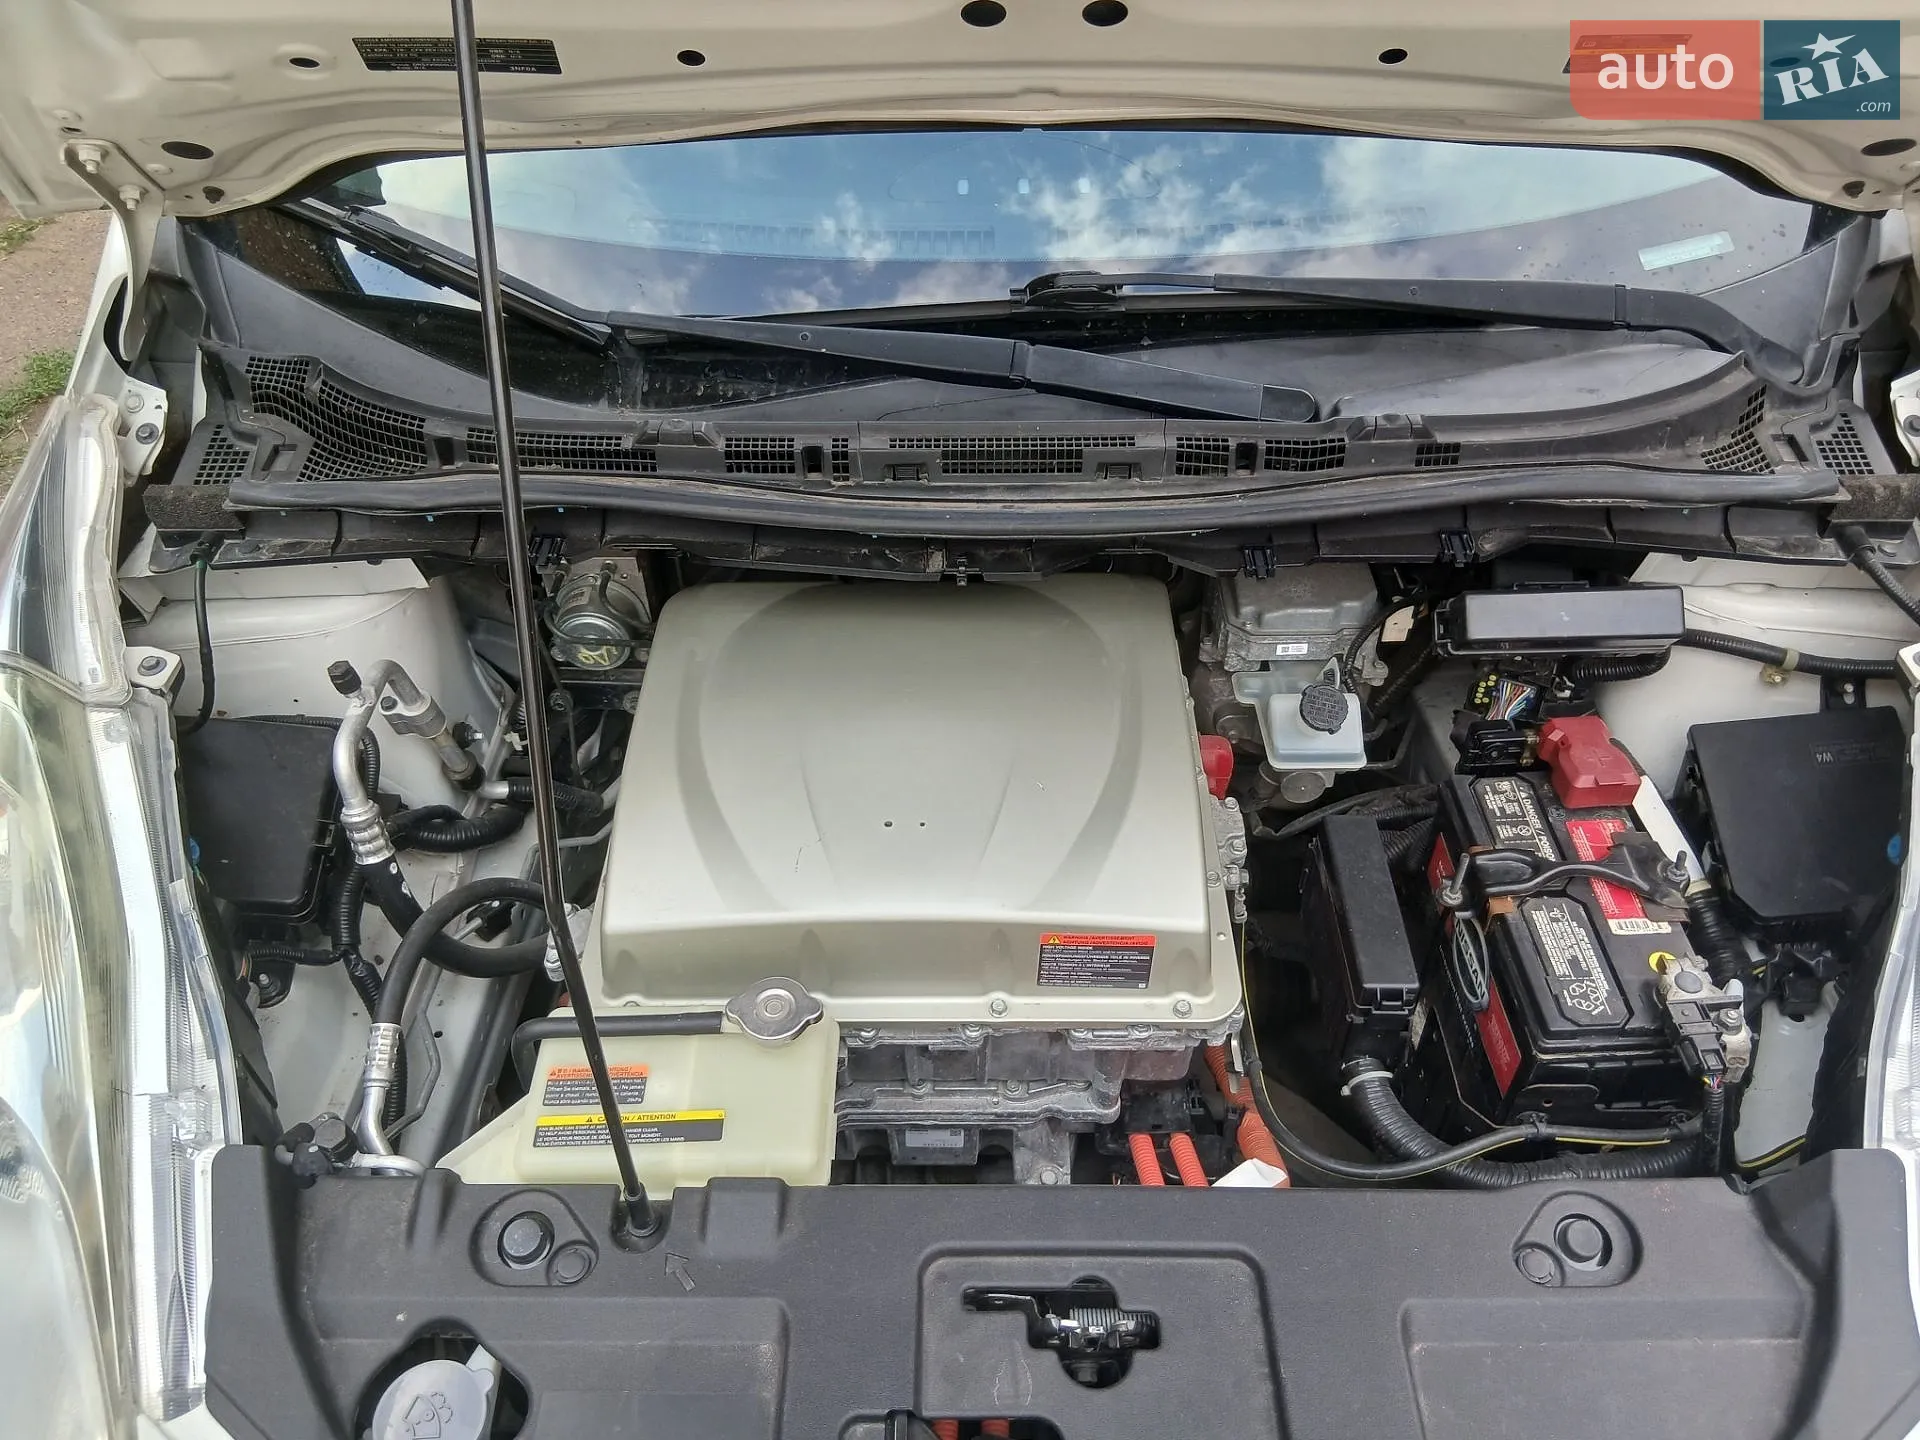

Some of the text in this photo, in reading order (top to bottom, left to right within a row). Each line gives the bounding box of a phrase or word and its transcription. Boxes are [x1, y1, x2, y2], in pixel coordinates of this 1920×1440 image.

[1522, 799, 1542, 828] DANGER
[1456, 919, 1486, 1000] NISSAN
[636, 1113, 676, 1121] ATTENTION
